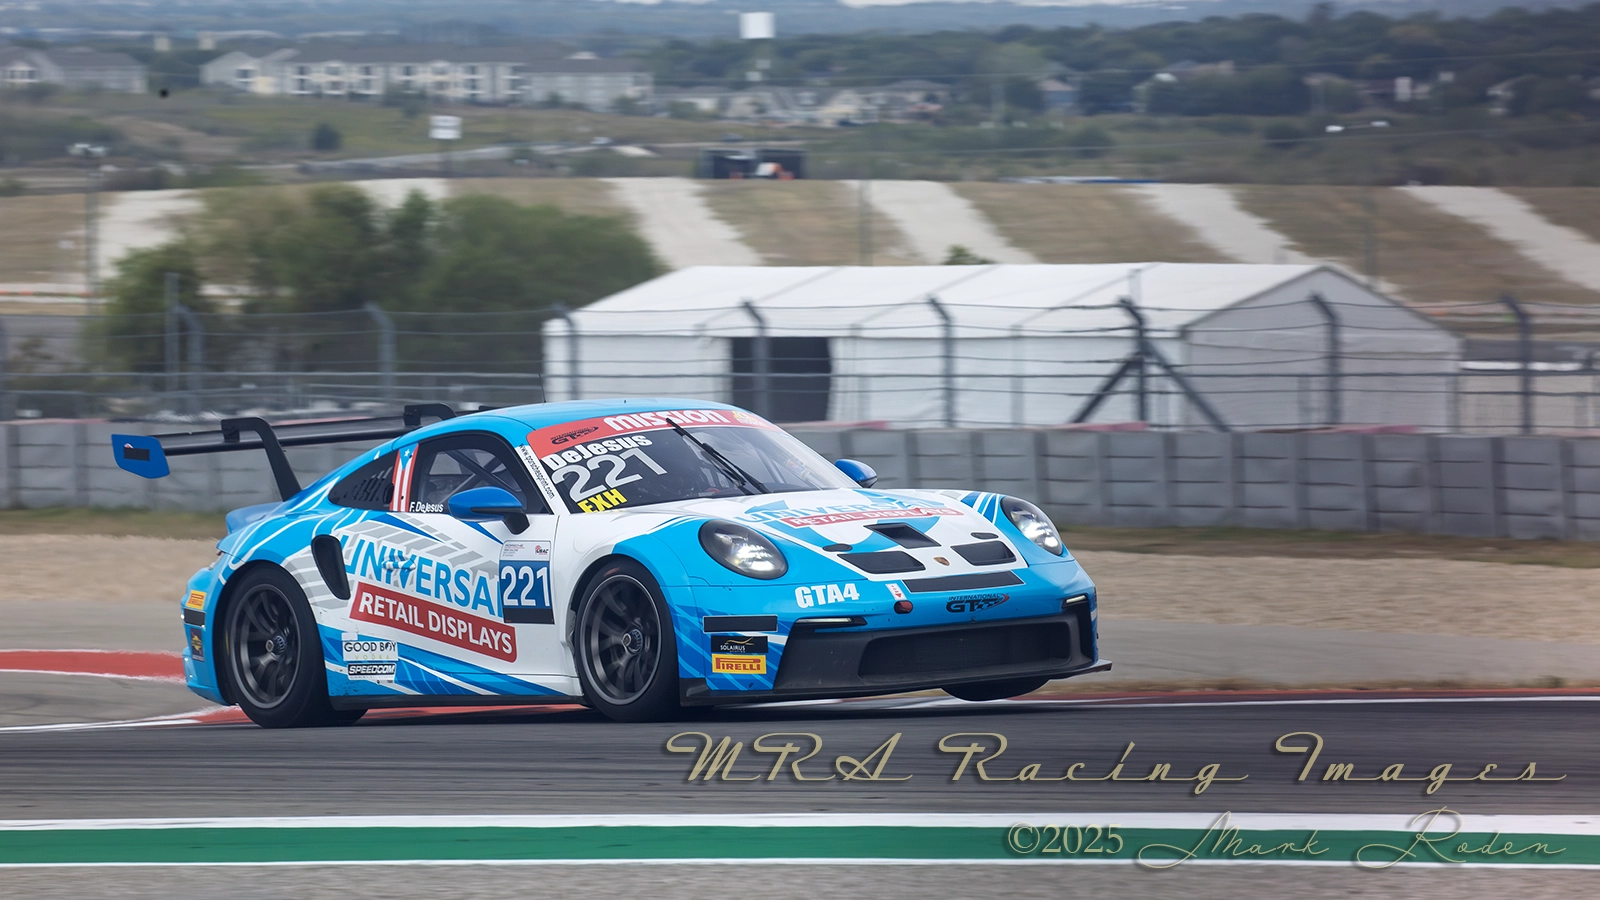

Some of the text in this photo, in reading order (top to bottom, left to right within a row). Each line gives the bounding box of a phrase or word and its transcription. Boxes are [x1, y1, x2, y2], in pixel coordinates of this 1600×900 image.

[541, 435, 653, 471] DeJesus
[551, 447, 668, 503] 221
[577, 488, 628, 513] EXH
[789, 507, 958, 525] RETAIL DISPLAYS
[500, 565, 551, 607] 221
[794, 582, 860, 609] GTA4
[948, 593, 1000, 601] INTERNATIONAL
[358, 591, 513, 654] RETAIL DISPLAYS
[344, 641, 397, 652] GOOD BOY
[349, 664, 396, 675] SPEEDCOM
[715, 657, 762, 671] PIRELLI
